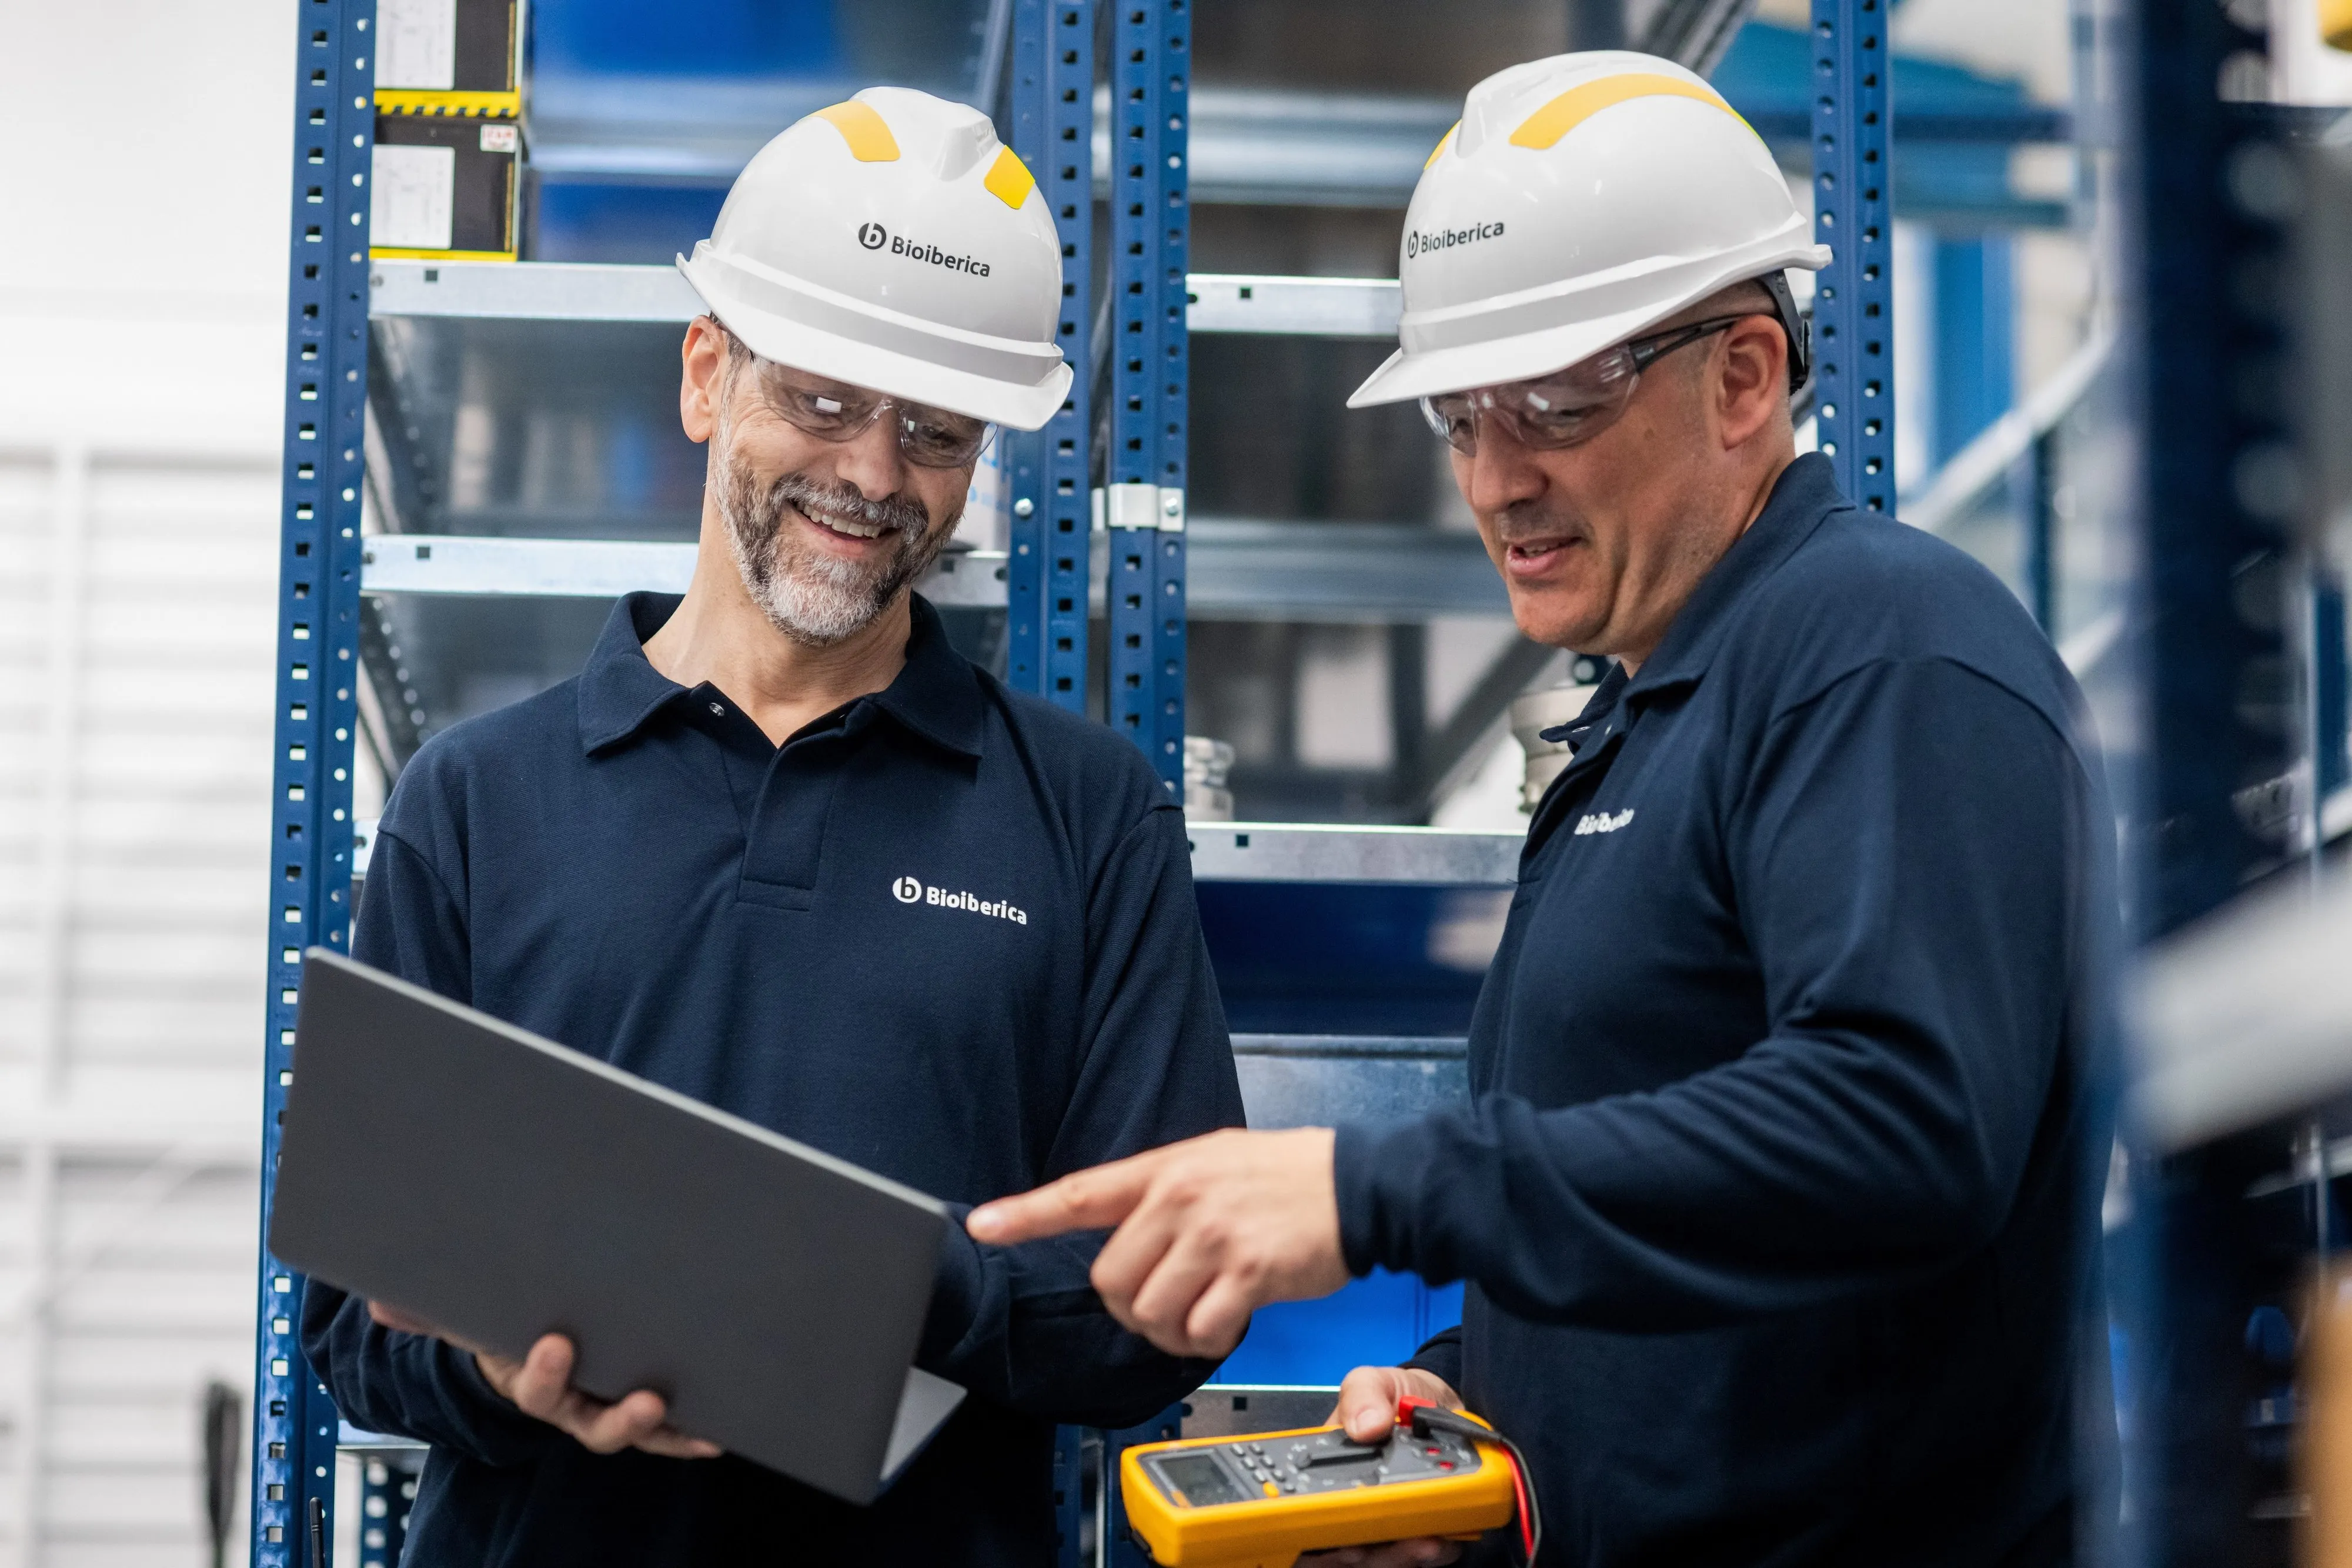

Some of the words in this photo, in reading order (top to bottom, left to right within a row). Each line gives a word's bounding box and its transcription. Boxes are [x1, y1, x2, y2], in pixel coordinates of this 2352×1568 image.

[891, 236, 990, 278] Bioiberica
[1421, 222, 1505, 253] Bioiberica
[926, 886, 1027, 925] Bioiberica
